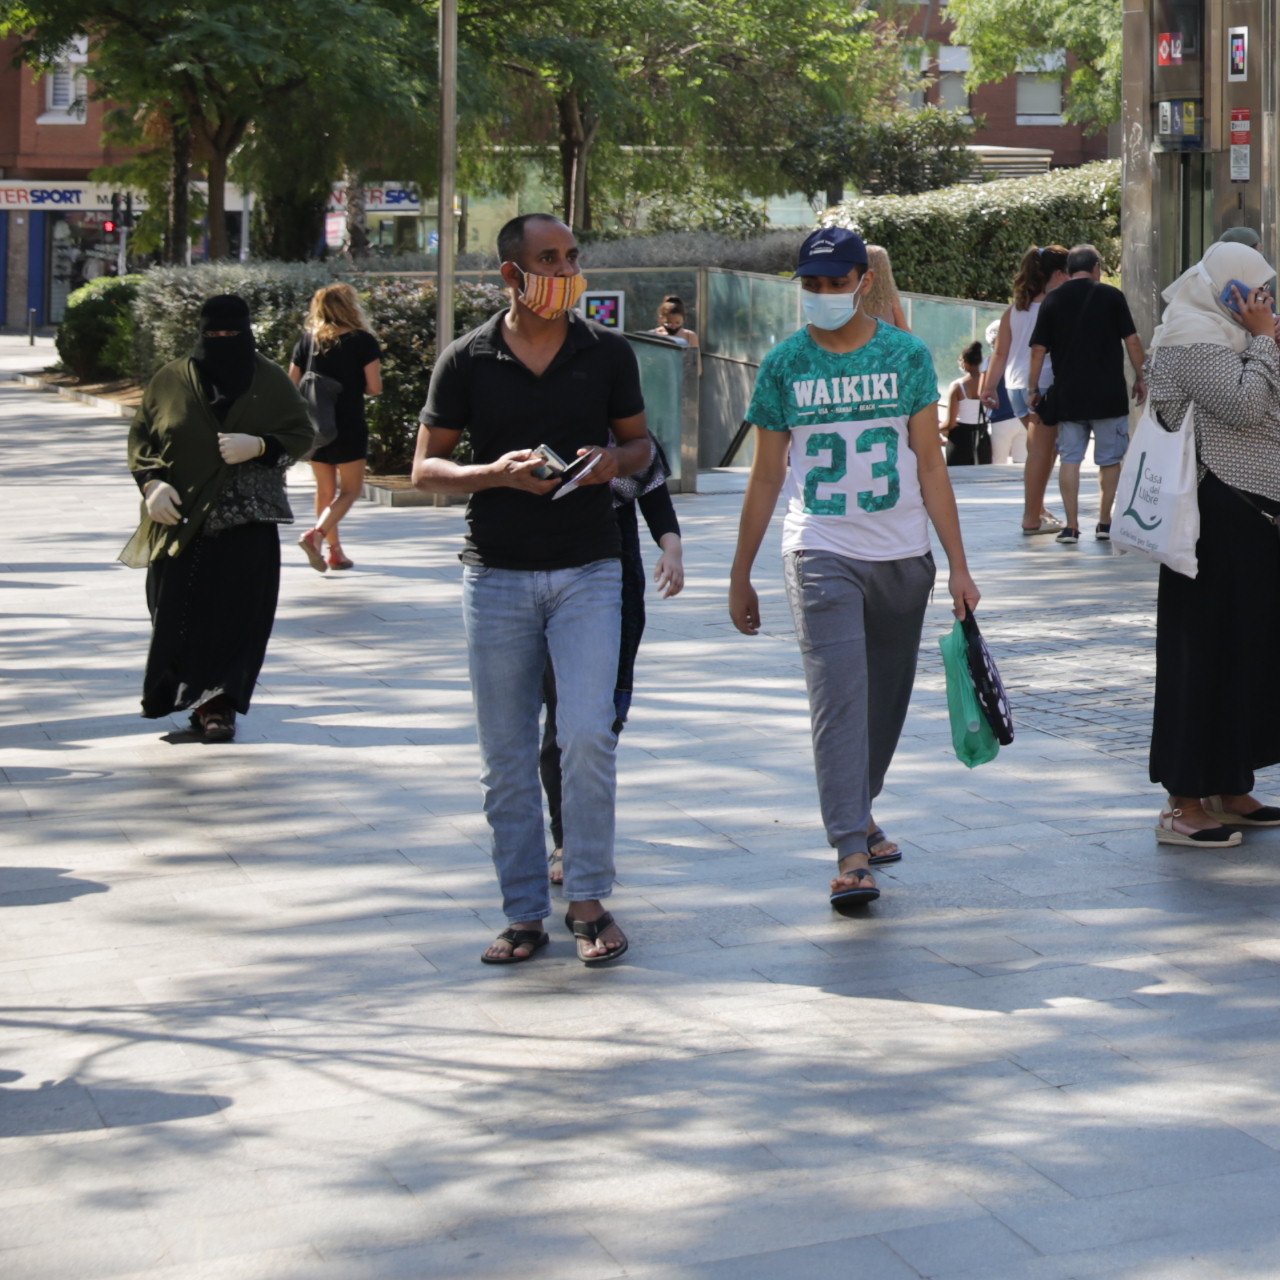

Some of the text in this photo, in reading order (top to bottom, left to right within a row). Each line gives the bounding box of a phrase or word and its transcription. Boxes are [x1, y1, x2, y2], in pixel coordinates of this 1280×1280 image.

[1171, 39, 1182, 58] L2
[792, 372, 899, 408] WAIKIKI
[803, 425, 900, 515] 23
[1144, 467, 1162, 484] Casa
[1138, 487, 1159, 506] Llibre
[1149, 485, 1160, 495] del
